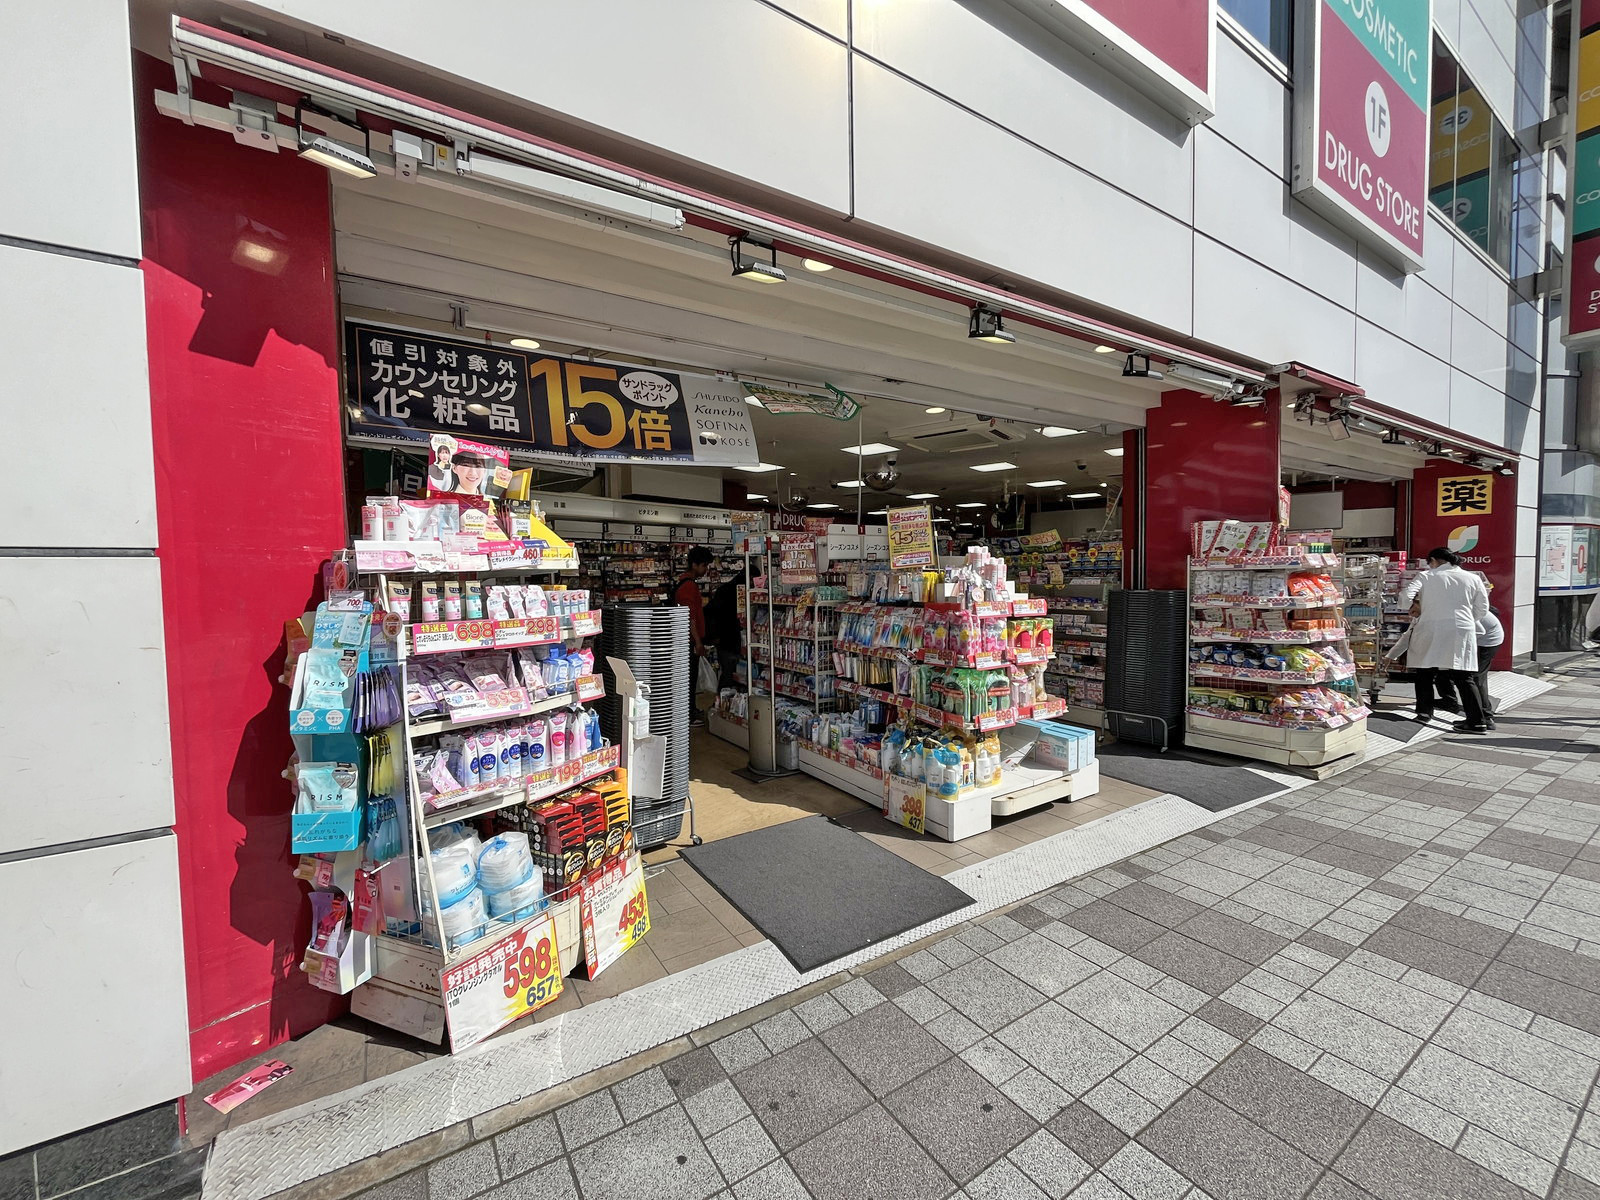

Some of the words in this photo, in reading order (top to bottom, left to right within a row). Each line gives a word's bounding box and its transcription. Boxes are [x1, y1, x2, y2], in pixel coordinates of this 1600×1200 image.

[1342, 0, 1418, 84] OSMETIC
[1371, 96, 1387, 139] 1F
[1325, 130, 1374, 202] DRUG
[1376, 176, 1419, 240] STORE
[1587, 301, 1600, 314] S
[369, 338, 517, 378] 値引対象外
[371, 359, 518, 402] カウンセリング
[622, 378, 672, 393] サンドラッグ
[633, 390, 667, 402] ポイント
[691, 391, 740, 403] SHISEIDO
[373, 386, 521, 433] 化粧品
[694, 404, 743, 417] Kanebo
[696, 419, 747, 432] SOFINA
[1441, 479, 1487, 512] 薬
[891, 530, 914, 545] 15
[523, 548, 538, 560] 460
[456, 622, 493, 641] 698
[526, 618, 555, 636] 298
[313, 679, 345, 688] RISM
[557, 761, 581, 782] 198
[902, 794, 923, 817] 398
[908, 816, 922, 830] 437
[618, 891, 645, 931] 453
[632, 916, 646, 940] 498
[447, 939, 518, 989] 好評発売中
[503, 937, 551, 998] 598
[526, 975, 555, 1007] 657
